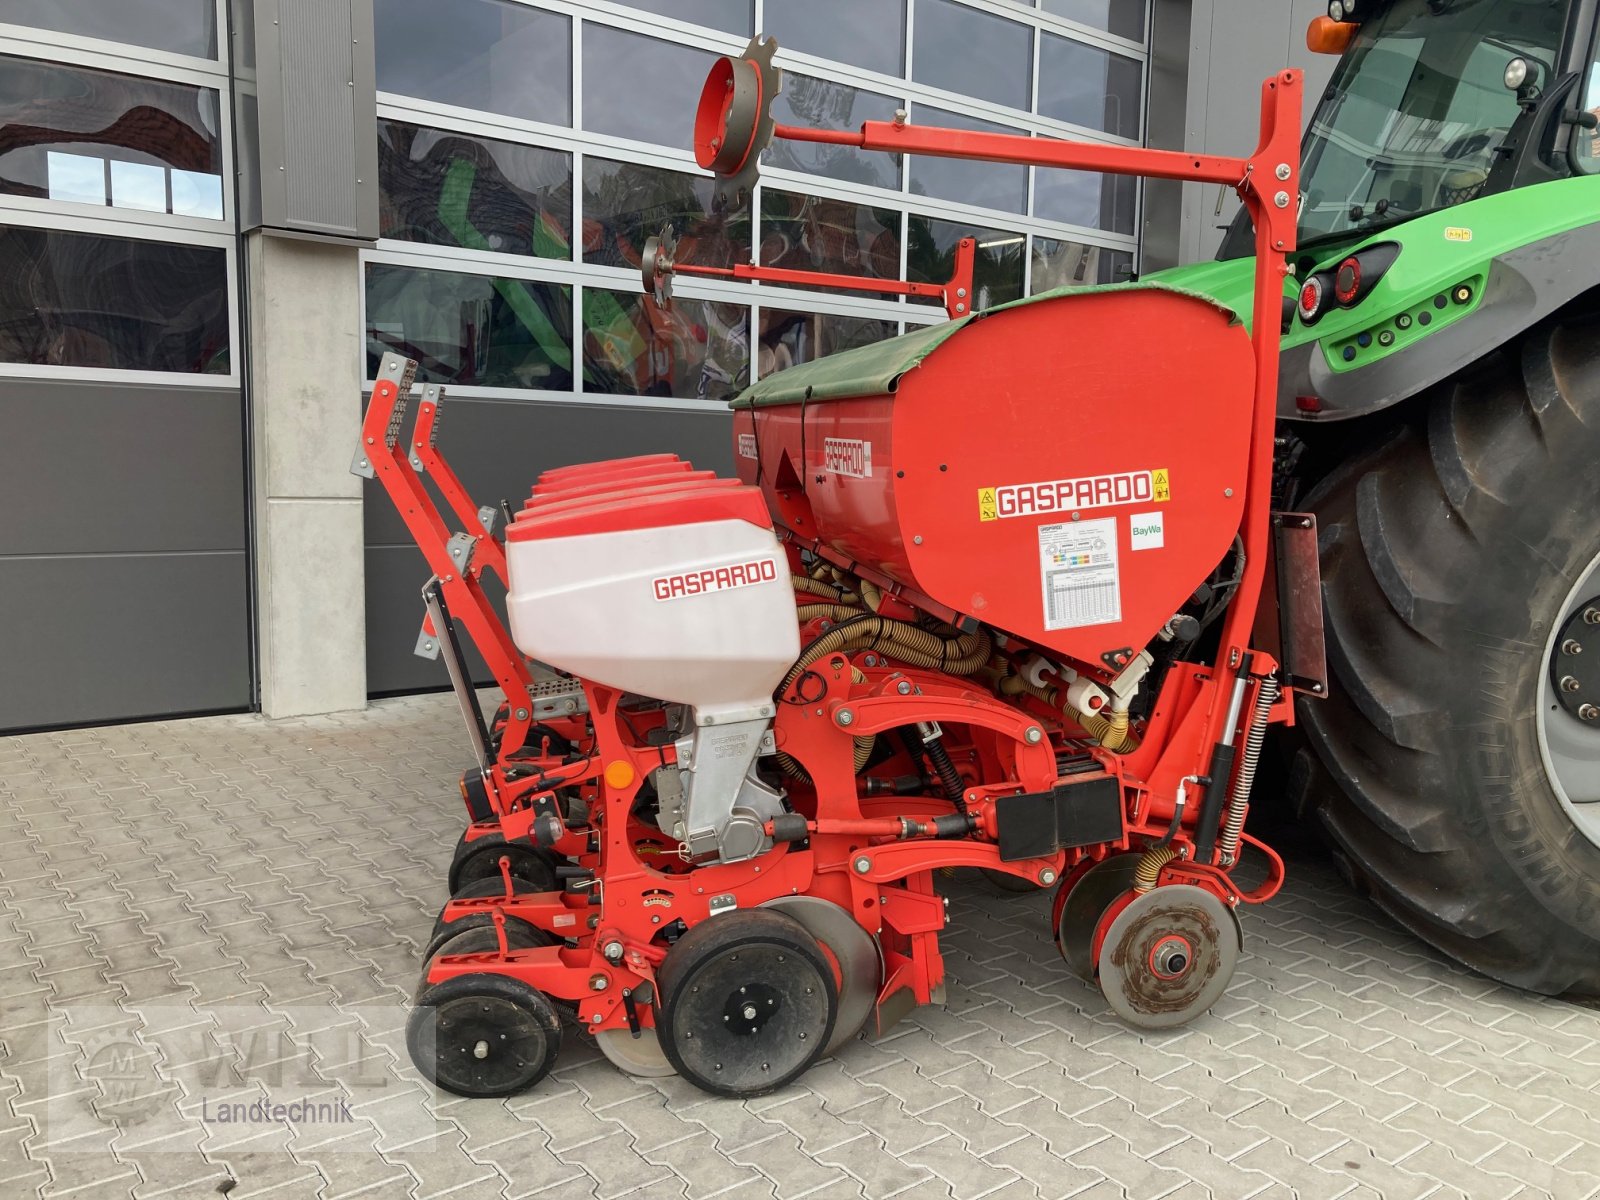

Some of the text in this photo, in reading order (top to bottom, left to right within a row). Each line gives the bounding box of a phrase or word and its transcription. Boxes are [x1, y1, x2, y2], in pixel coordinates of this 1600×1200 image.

[825, 440, 863, 474] GASPARDO
[997, 473, 1150, 516] GASPARDO
[1132, 525, 1162, 537] BayWa
[654, 560, 776, 600] GASPARDO
